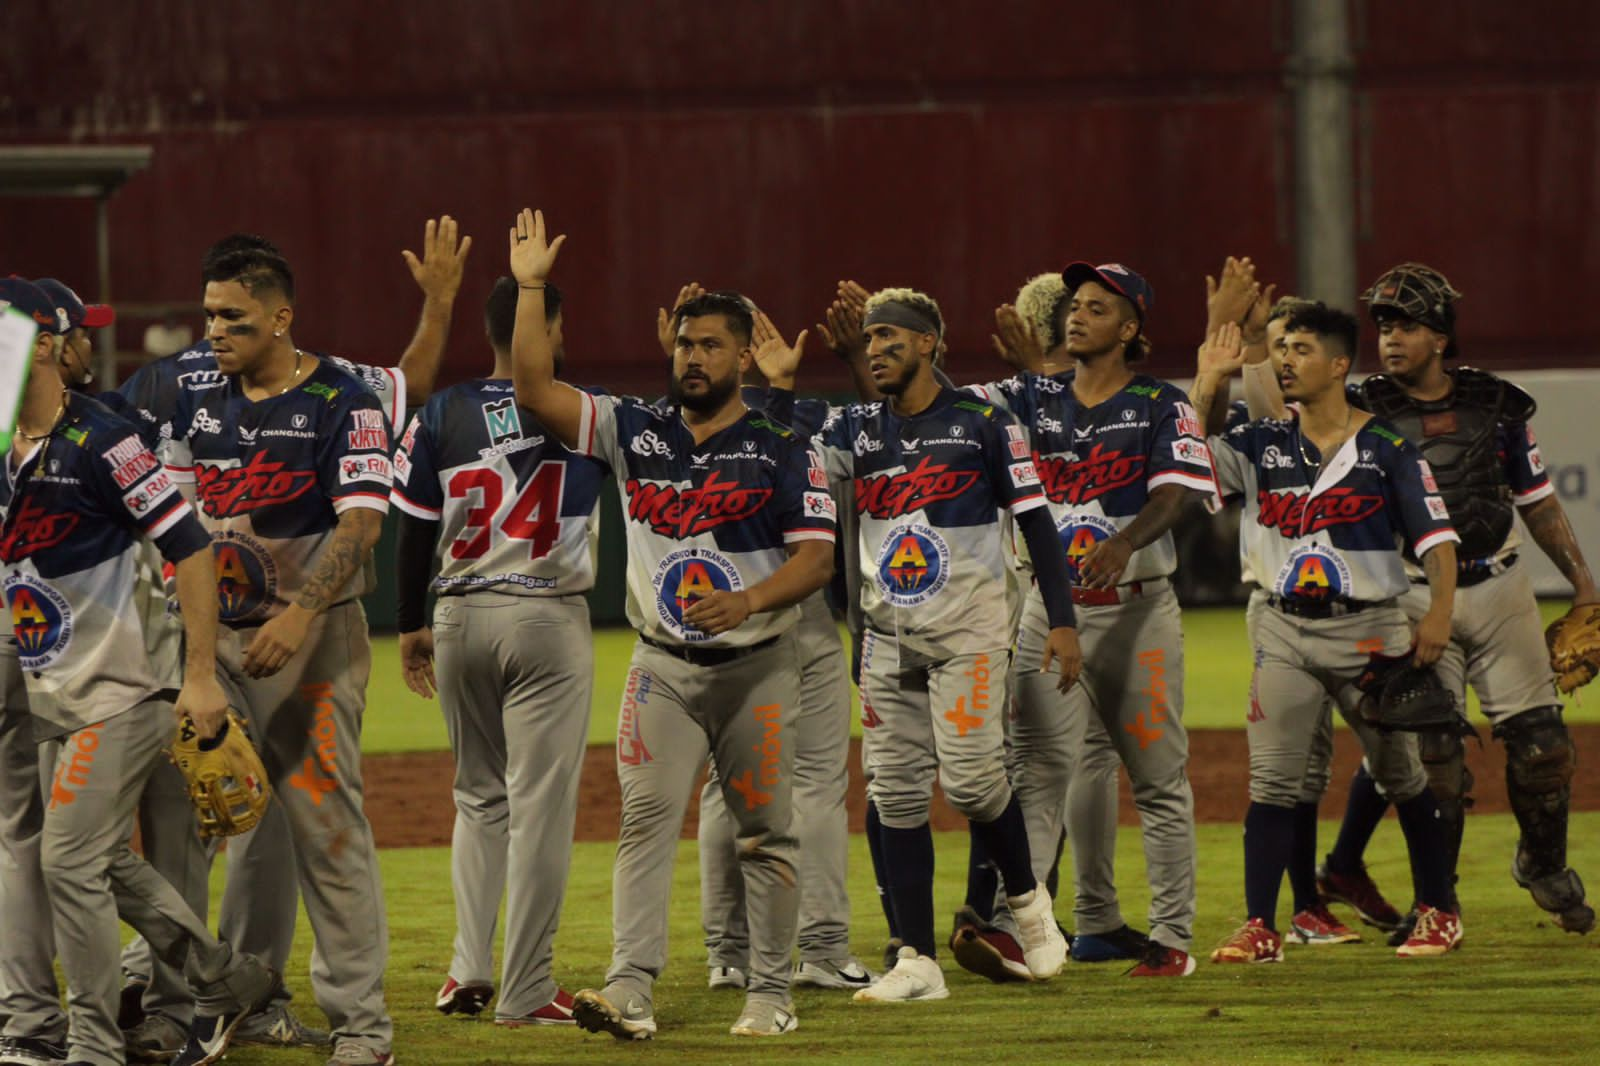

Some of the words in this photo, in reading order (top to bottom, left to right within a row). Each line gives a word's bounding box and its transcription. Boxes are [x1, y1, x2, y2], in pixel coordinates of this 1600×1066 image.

[626, 470, 774, 539] Metro
[854, 455, 983, 520] Metro
[1031, 442, 1147, 507] Metro
[448, 459, 568, 561] 34
[1258, 487, 1385, 539] Metro
[700, 549, 741, 587] TRANSPORTE
